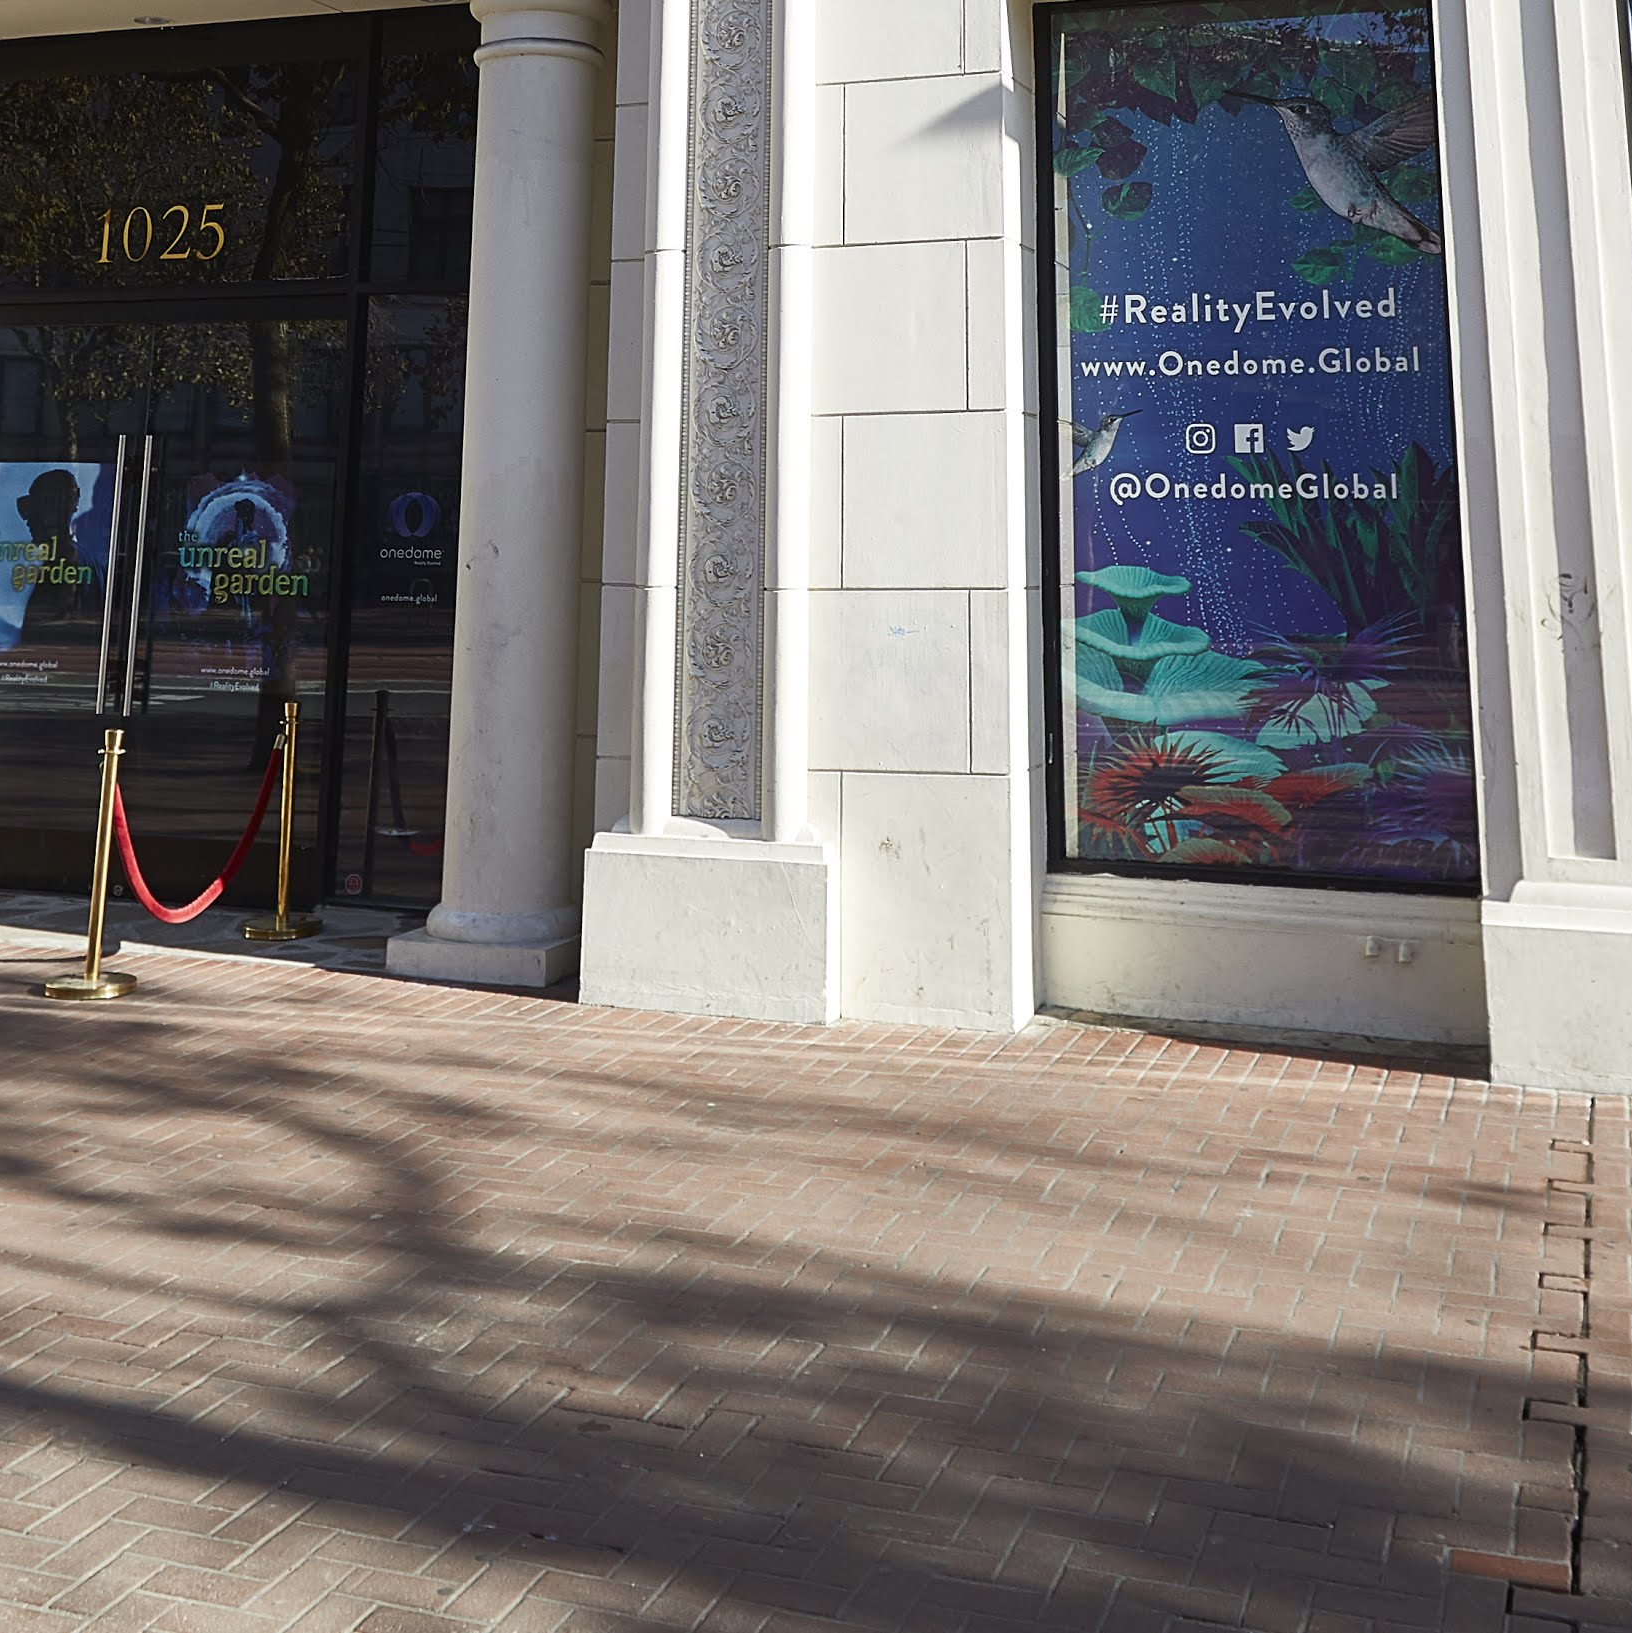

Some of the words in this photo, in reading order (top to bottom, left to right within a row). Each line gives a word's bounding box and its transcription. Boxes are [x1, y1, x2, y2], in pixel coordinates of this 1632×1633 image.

[95, 203, 225, 264] 1025
[1099, 287, 1397, 334] #RealityEvolved
[1081, 346, 1421, 378] www.Onedome.Global
[1109, 473, 1399, 506] @OnedomeGlobal
[178, 530, 197, 542] the
[178, 540, 267, 568] unreal
[380, 546, 442, 559] onedome
[12, 558, 92, 592] garden
[213, 566, 308, 604] garden
[381, 594, 438, 604] onedome.global
[200, 667, 270, 678] www.onedome.global
